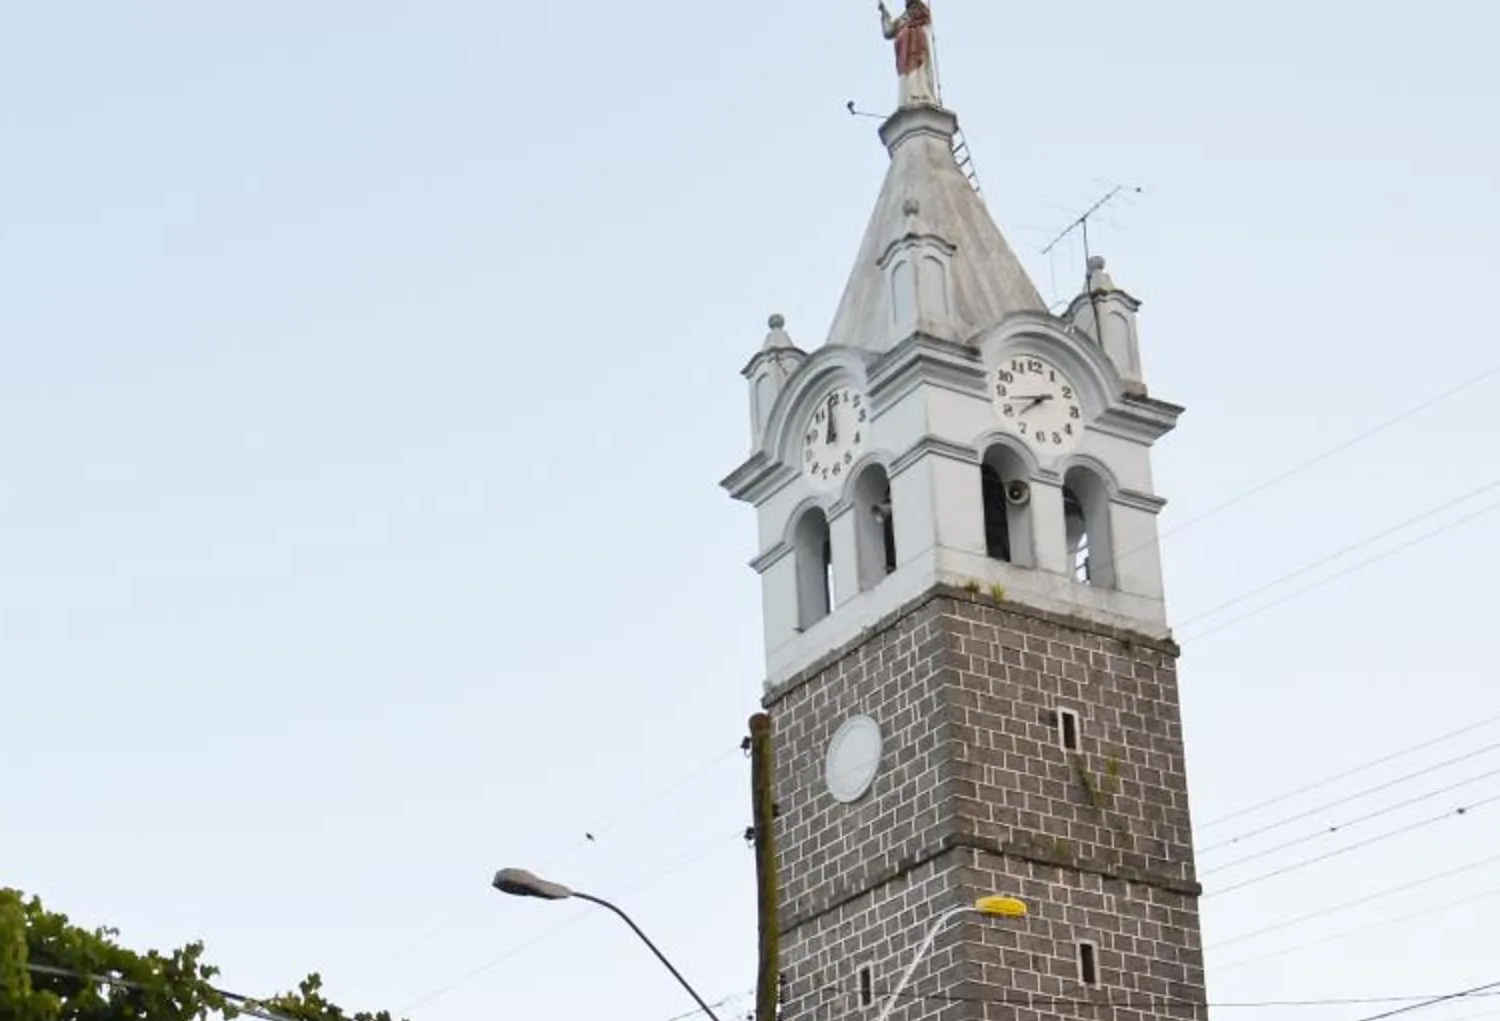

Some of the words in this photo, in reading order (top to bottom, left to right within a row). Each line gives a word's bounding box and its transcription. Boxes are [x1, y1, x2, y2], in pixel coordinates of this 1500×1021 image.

[1011, 360, 1025, 374] 11
[1027, 360, 1043, 374] 12
[1049, 370, 1055, 382] 1
[1062, 386, 1072, 399] 2
[1018, 422, 1027, 434] 7
